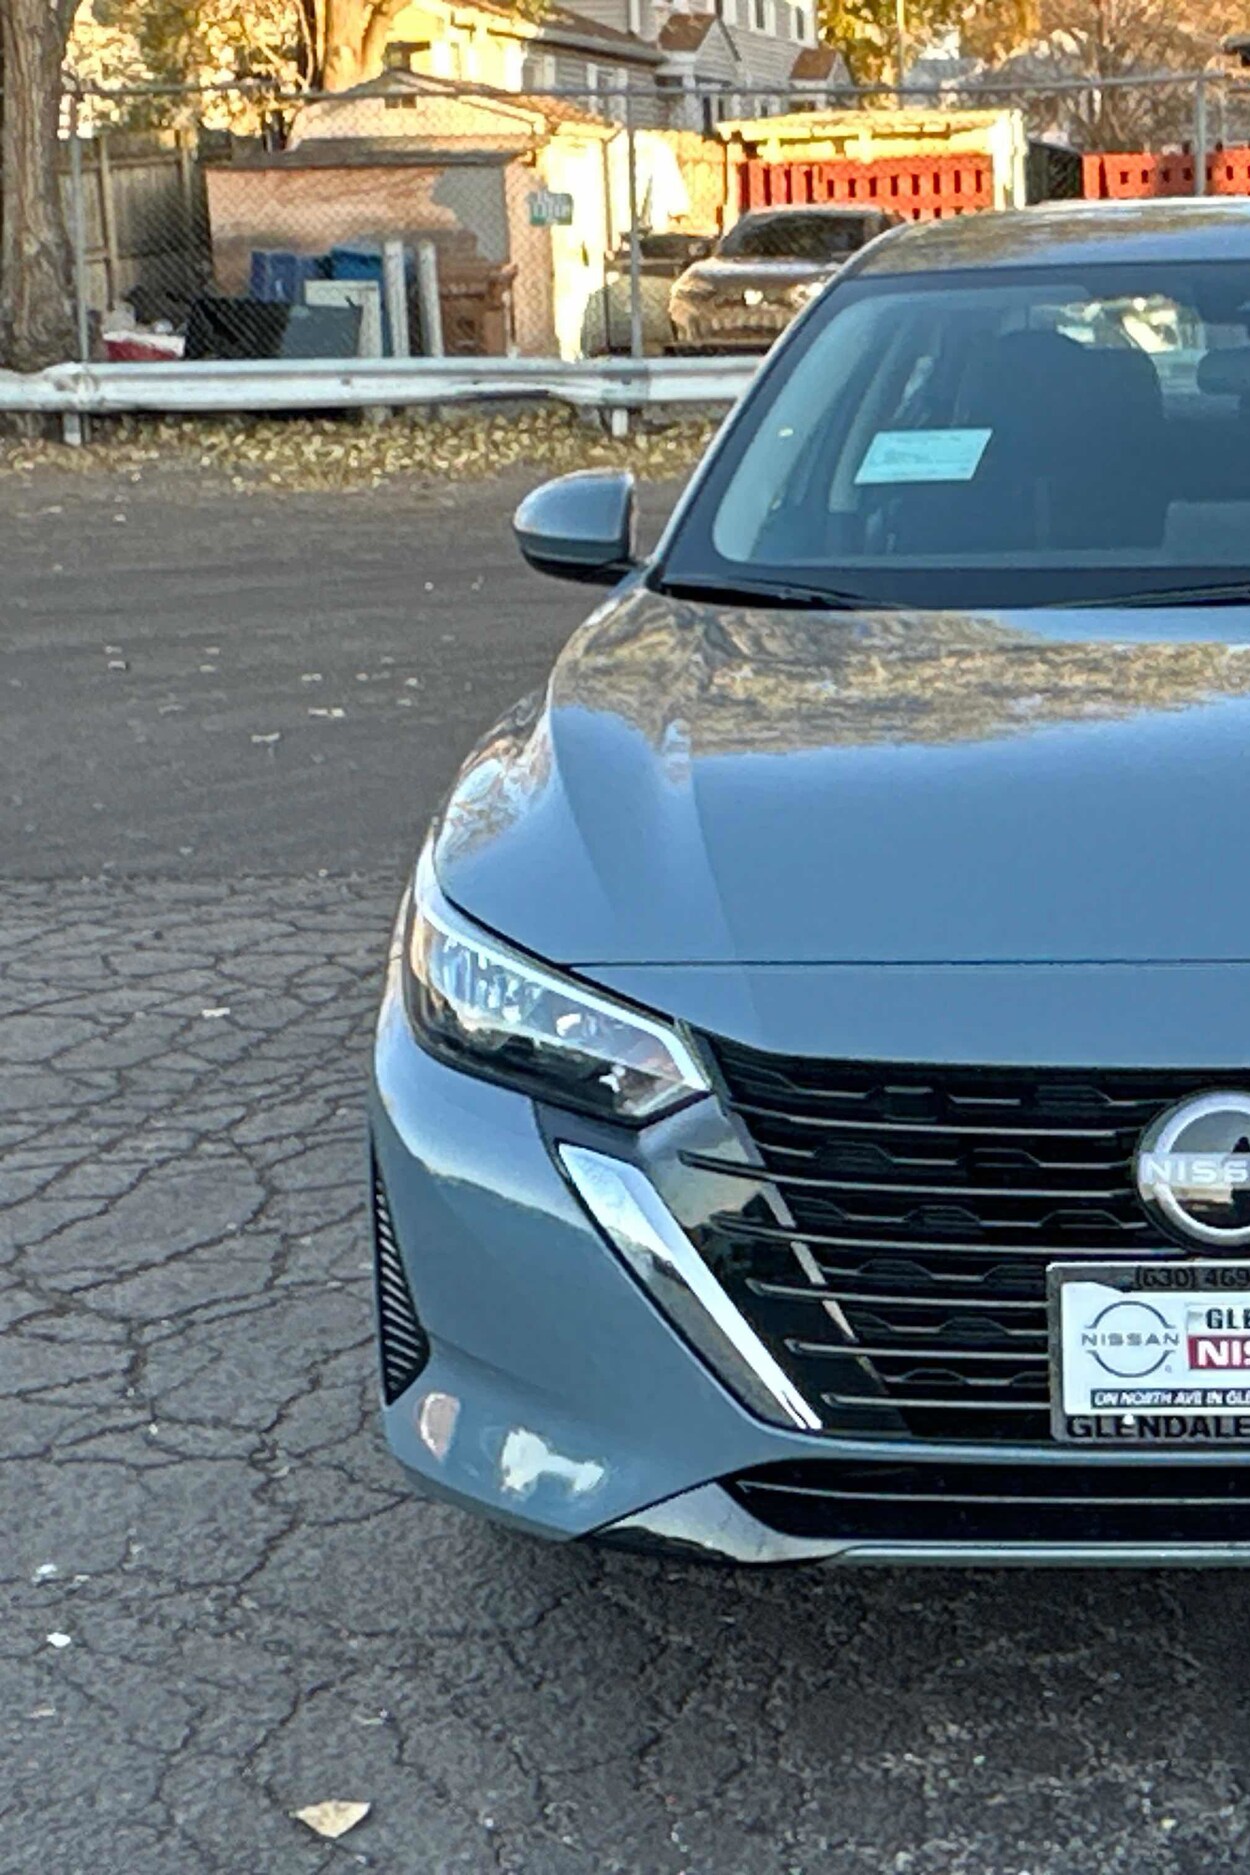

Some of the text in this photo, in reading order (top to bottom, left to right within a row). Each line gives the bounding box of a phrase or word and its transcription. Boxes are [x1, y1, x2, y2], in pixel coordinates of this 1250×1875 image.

[1135, 1267, 1197, 1288] (630)
[1082, 1332, 1180, 1347] NISSAN
[1094, 1391, 1118, 1406] ON
[1120, 1391, 1172, 1406] NORTH
[1174, 1391, 1202, 1405] AVE
[1206, 1391, 1223, 1405] IN
